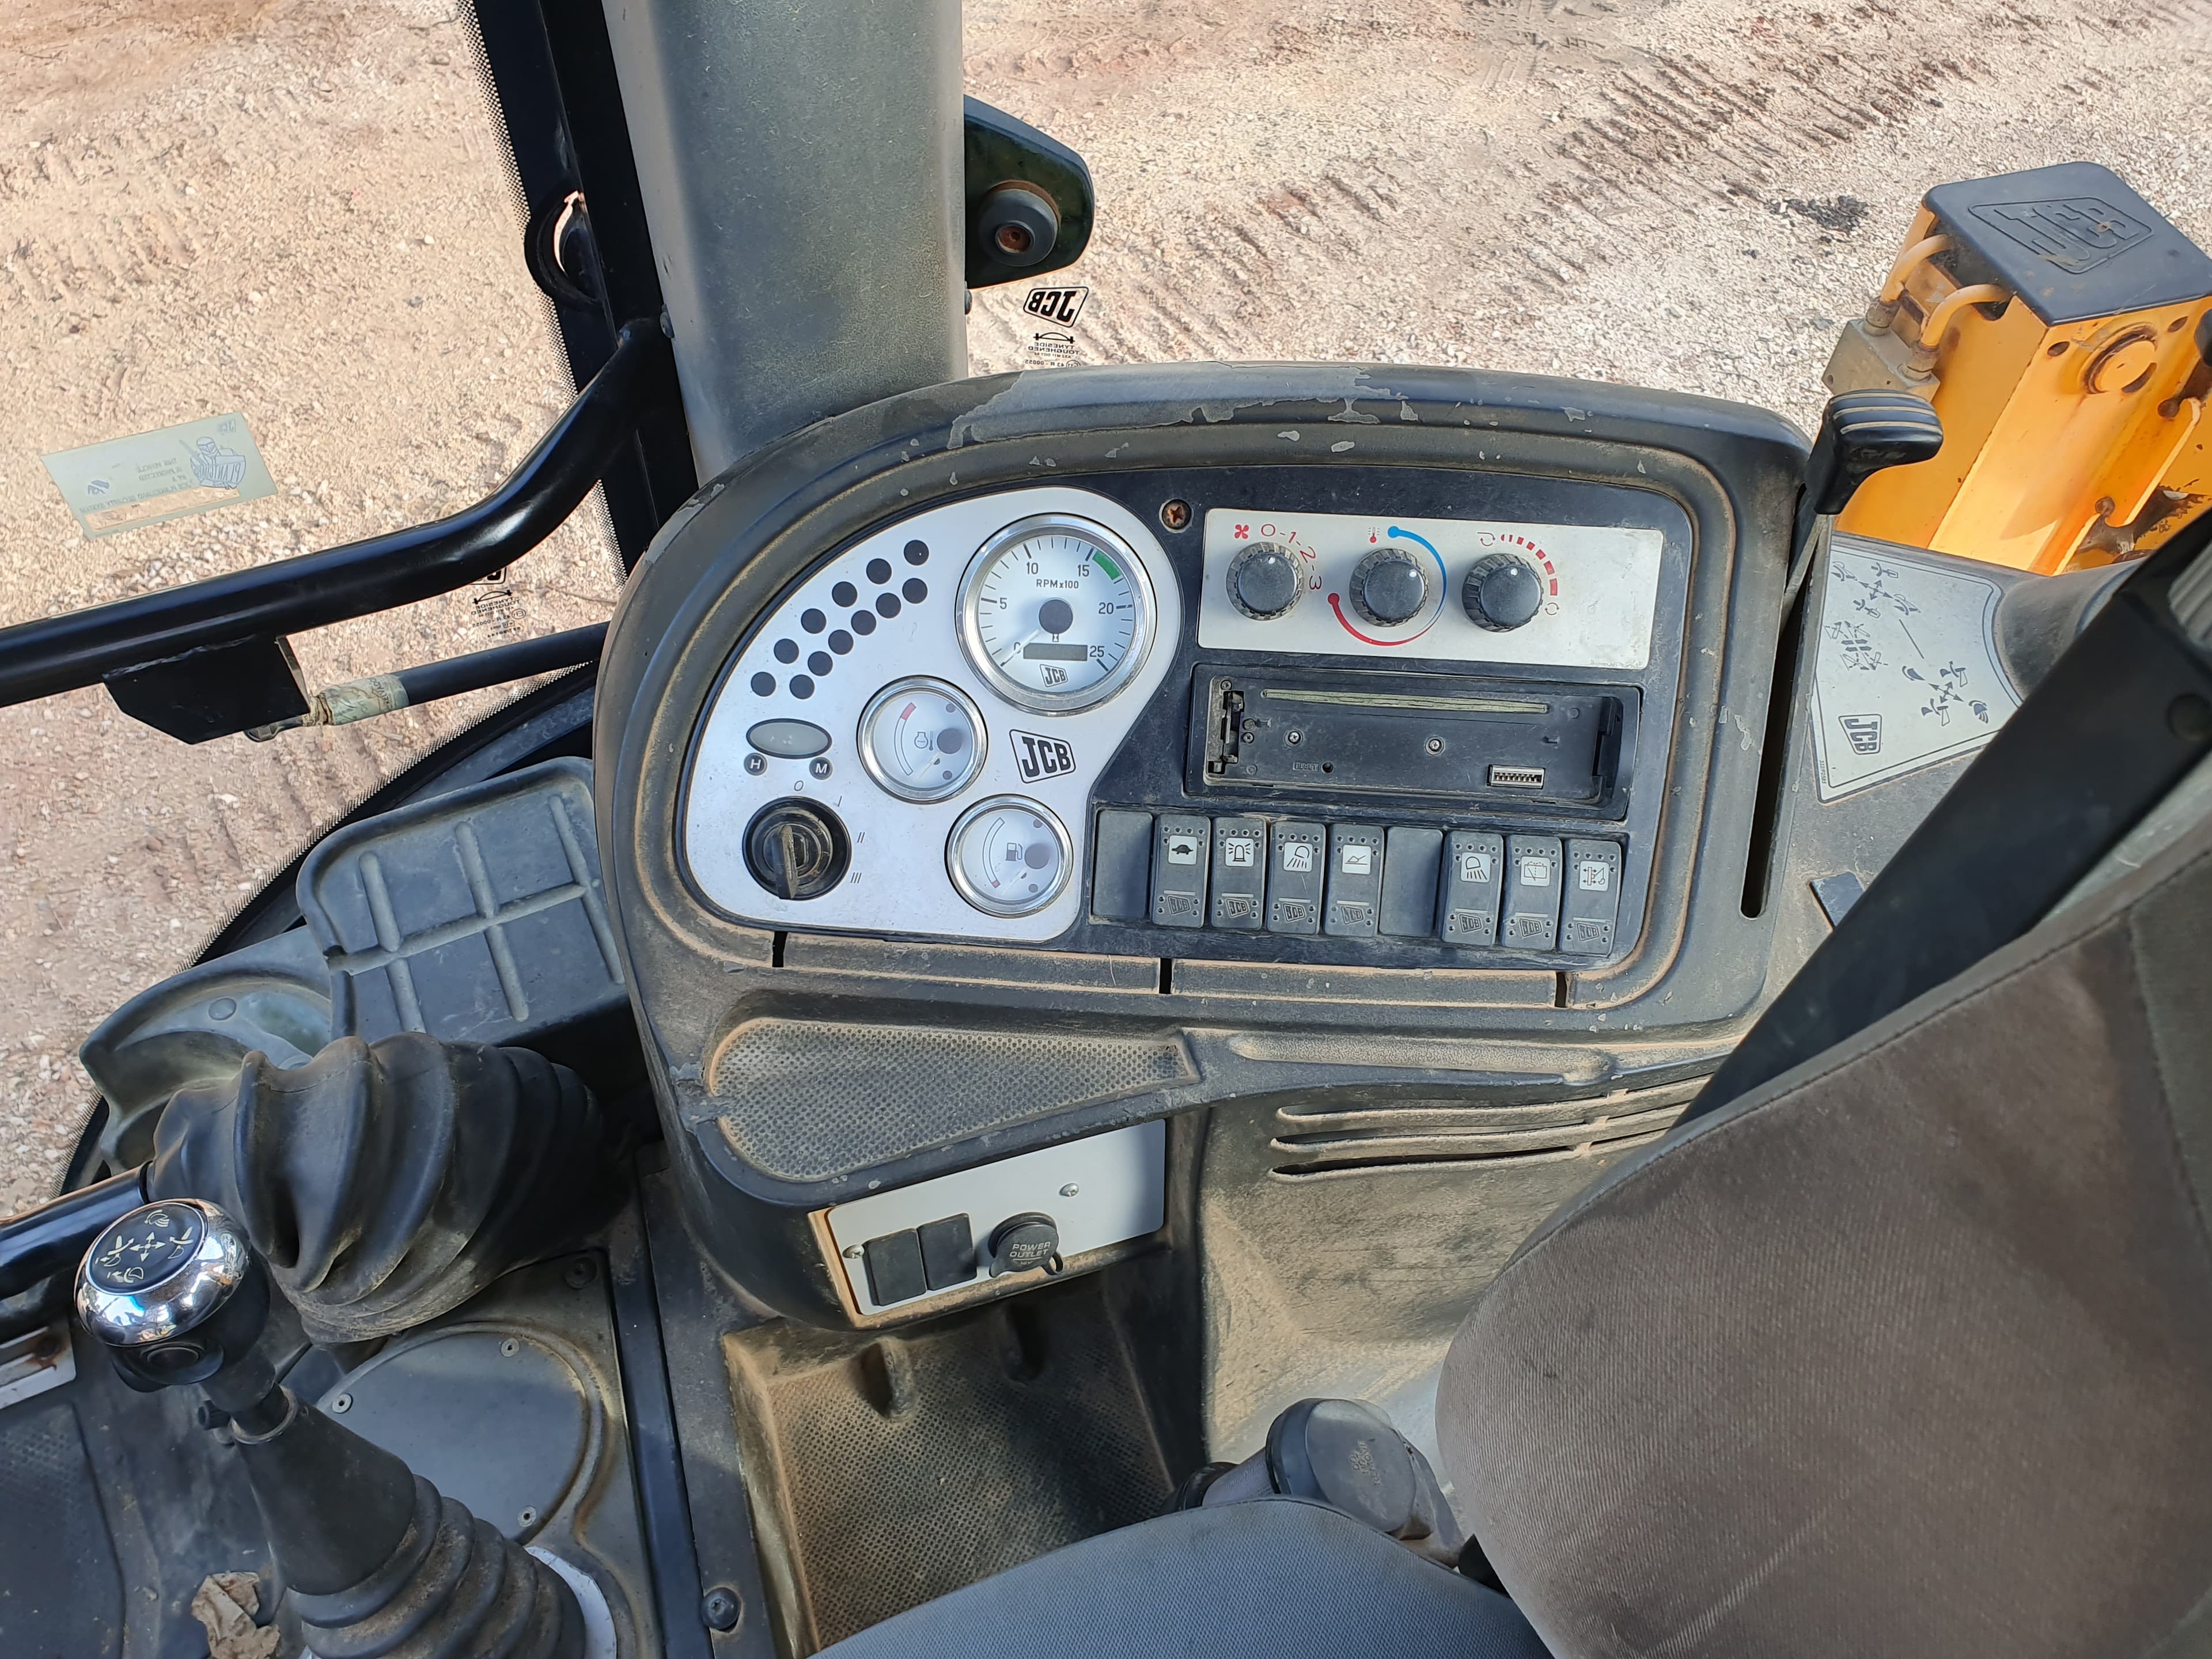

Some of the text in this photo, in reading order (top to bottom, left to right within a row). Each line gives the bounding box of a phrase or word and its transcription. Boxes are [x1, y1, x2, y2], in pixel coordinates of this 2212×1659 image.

[1994, 204, 2138, 265] JCB
[1027, 562, 1039, 575] 10
[1077, 565, 1090, 577] 15
[999, 597, 1007, 609] 5
[1099, 602, 1114, 614] 20
[1089, 646, 1105, 657] 25
[1044, 666, 1066, 685] JCB
[1844, 718, 1878, 752] JCB
[750, 759, 762, 770] H
[1021, 736, 1071, 778] JCB
[815, 763, 828, 774] M
[1169, 898, 1189, 913] JCB
[1228, 900, 1249, 916] JCB
[1285, 904, 1305, 921] JCB
[1342, 908, 1363, 923] JCB
[1460, 915, 1481, 931] JCB
[1520, 919, 1542, 936] JCB
[1578, 924, 1599, 941] JCB
[1009, 1249, 1048, 1257] OUTLET
[1012, 1241, 1051, 1251] POWER
